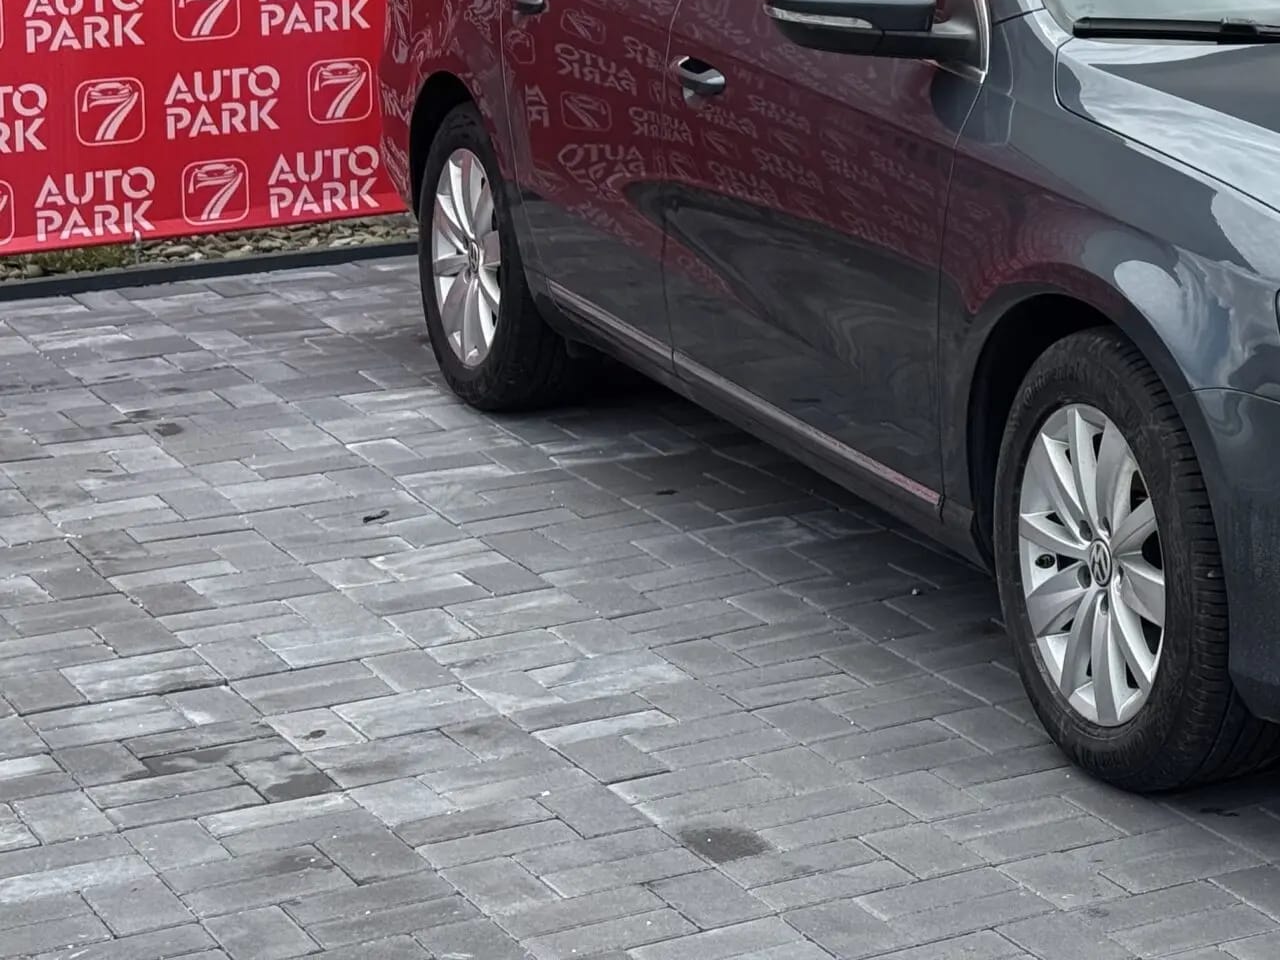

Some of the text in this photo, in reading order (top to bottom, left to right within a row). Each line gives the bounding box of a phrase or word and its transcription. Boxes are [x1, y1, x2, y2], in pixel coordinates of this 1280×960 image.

[26, 13, 144, 53] PARK
[165, 65, 280, 105] AUTO
[167, 98, 278, 139] PARK
[268, 146, 379, 185] AUTO
[35, 167, 155, 208] AUTO
[270, 178, 378, 216] PARK
[37, 201, 155, 240] PARK
